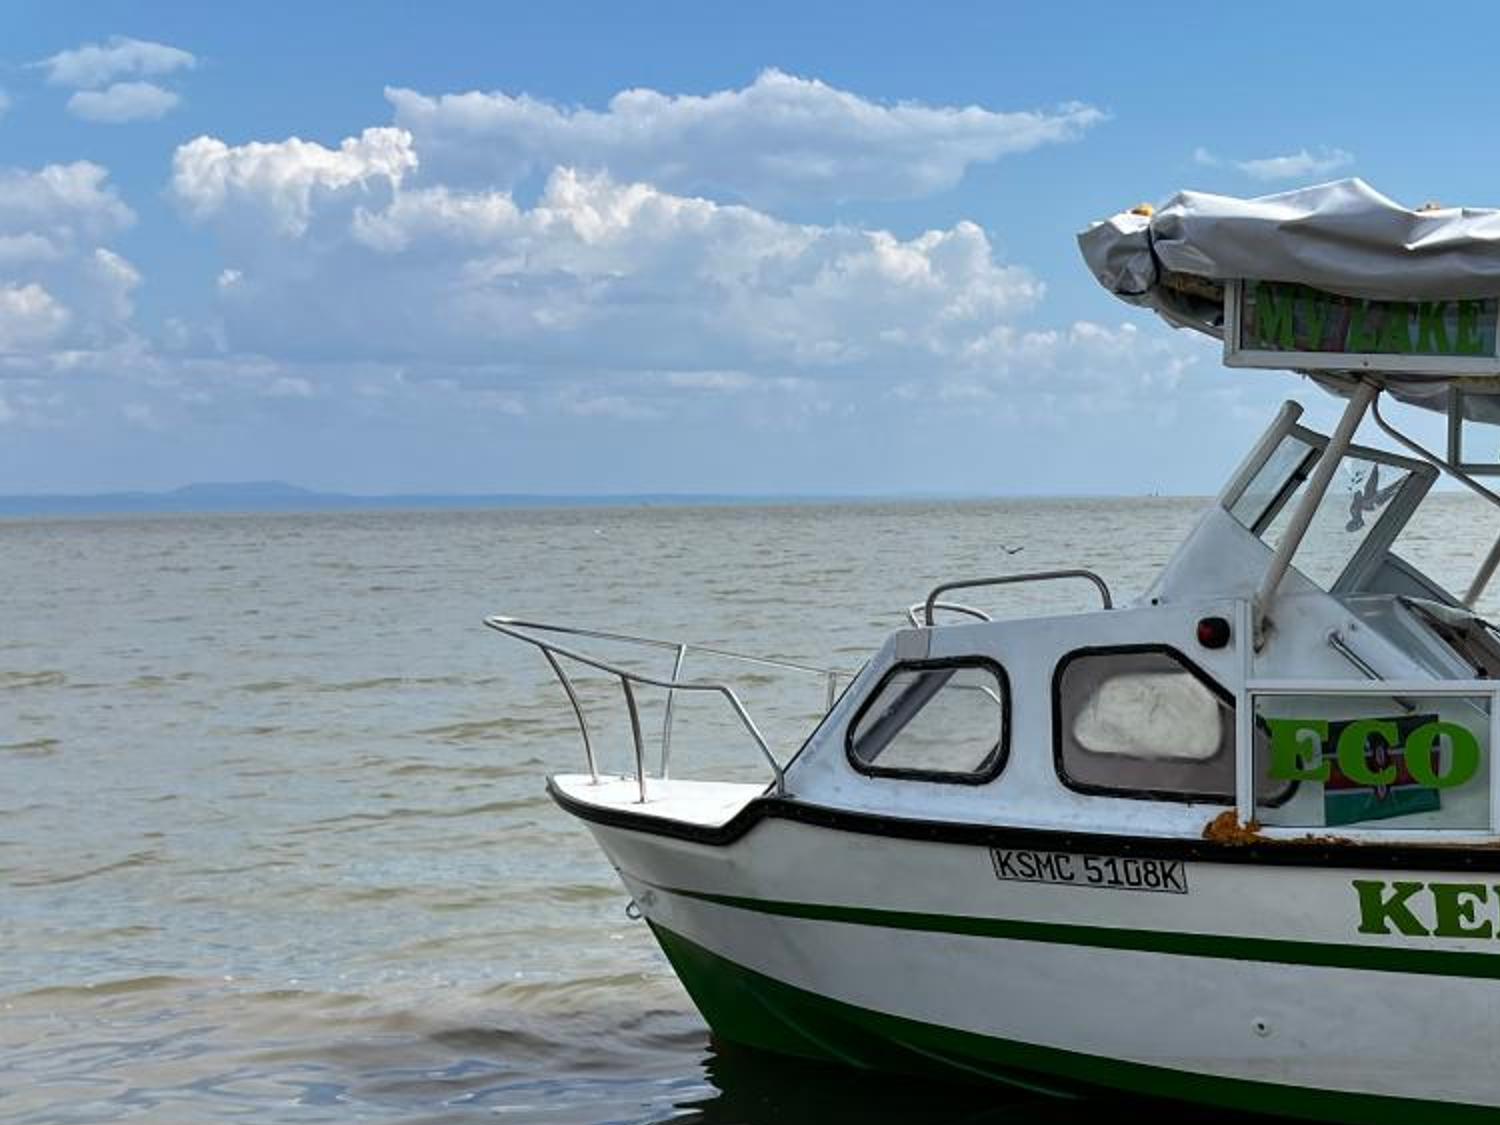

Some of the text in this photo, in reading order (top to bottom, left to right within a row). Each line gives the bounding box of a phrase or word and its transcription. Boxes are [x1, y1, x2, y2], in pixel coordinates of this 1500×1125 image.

[1347, 298, 1483, 356] LAKE
[1267, 718, 1481, 789] ECO
[996, 850, 1183, 890] KSMC 5108K
